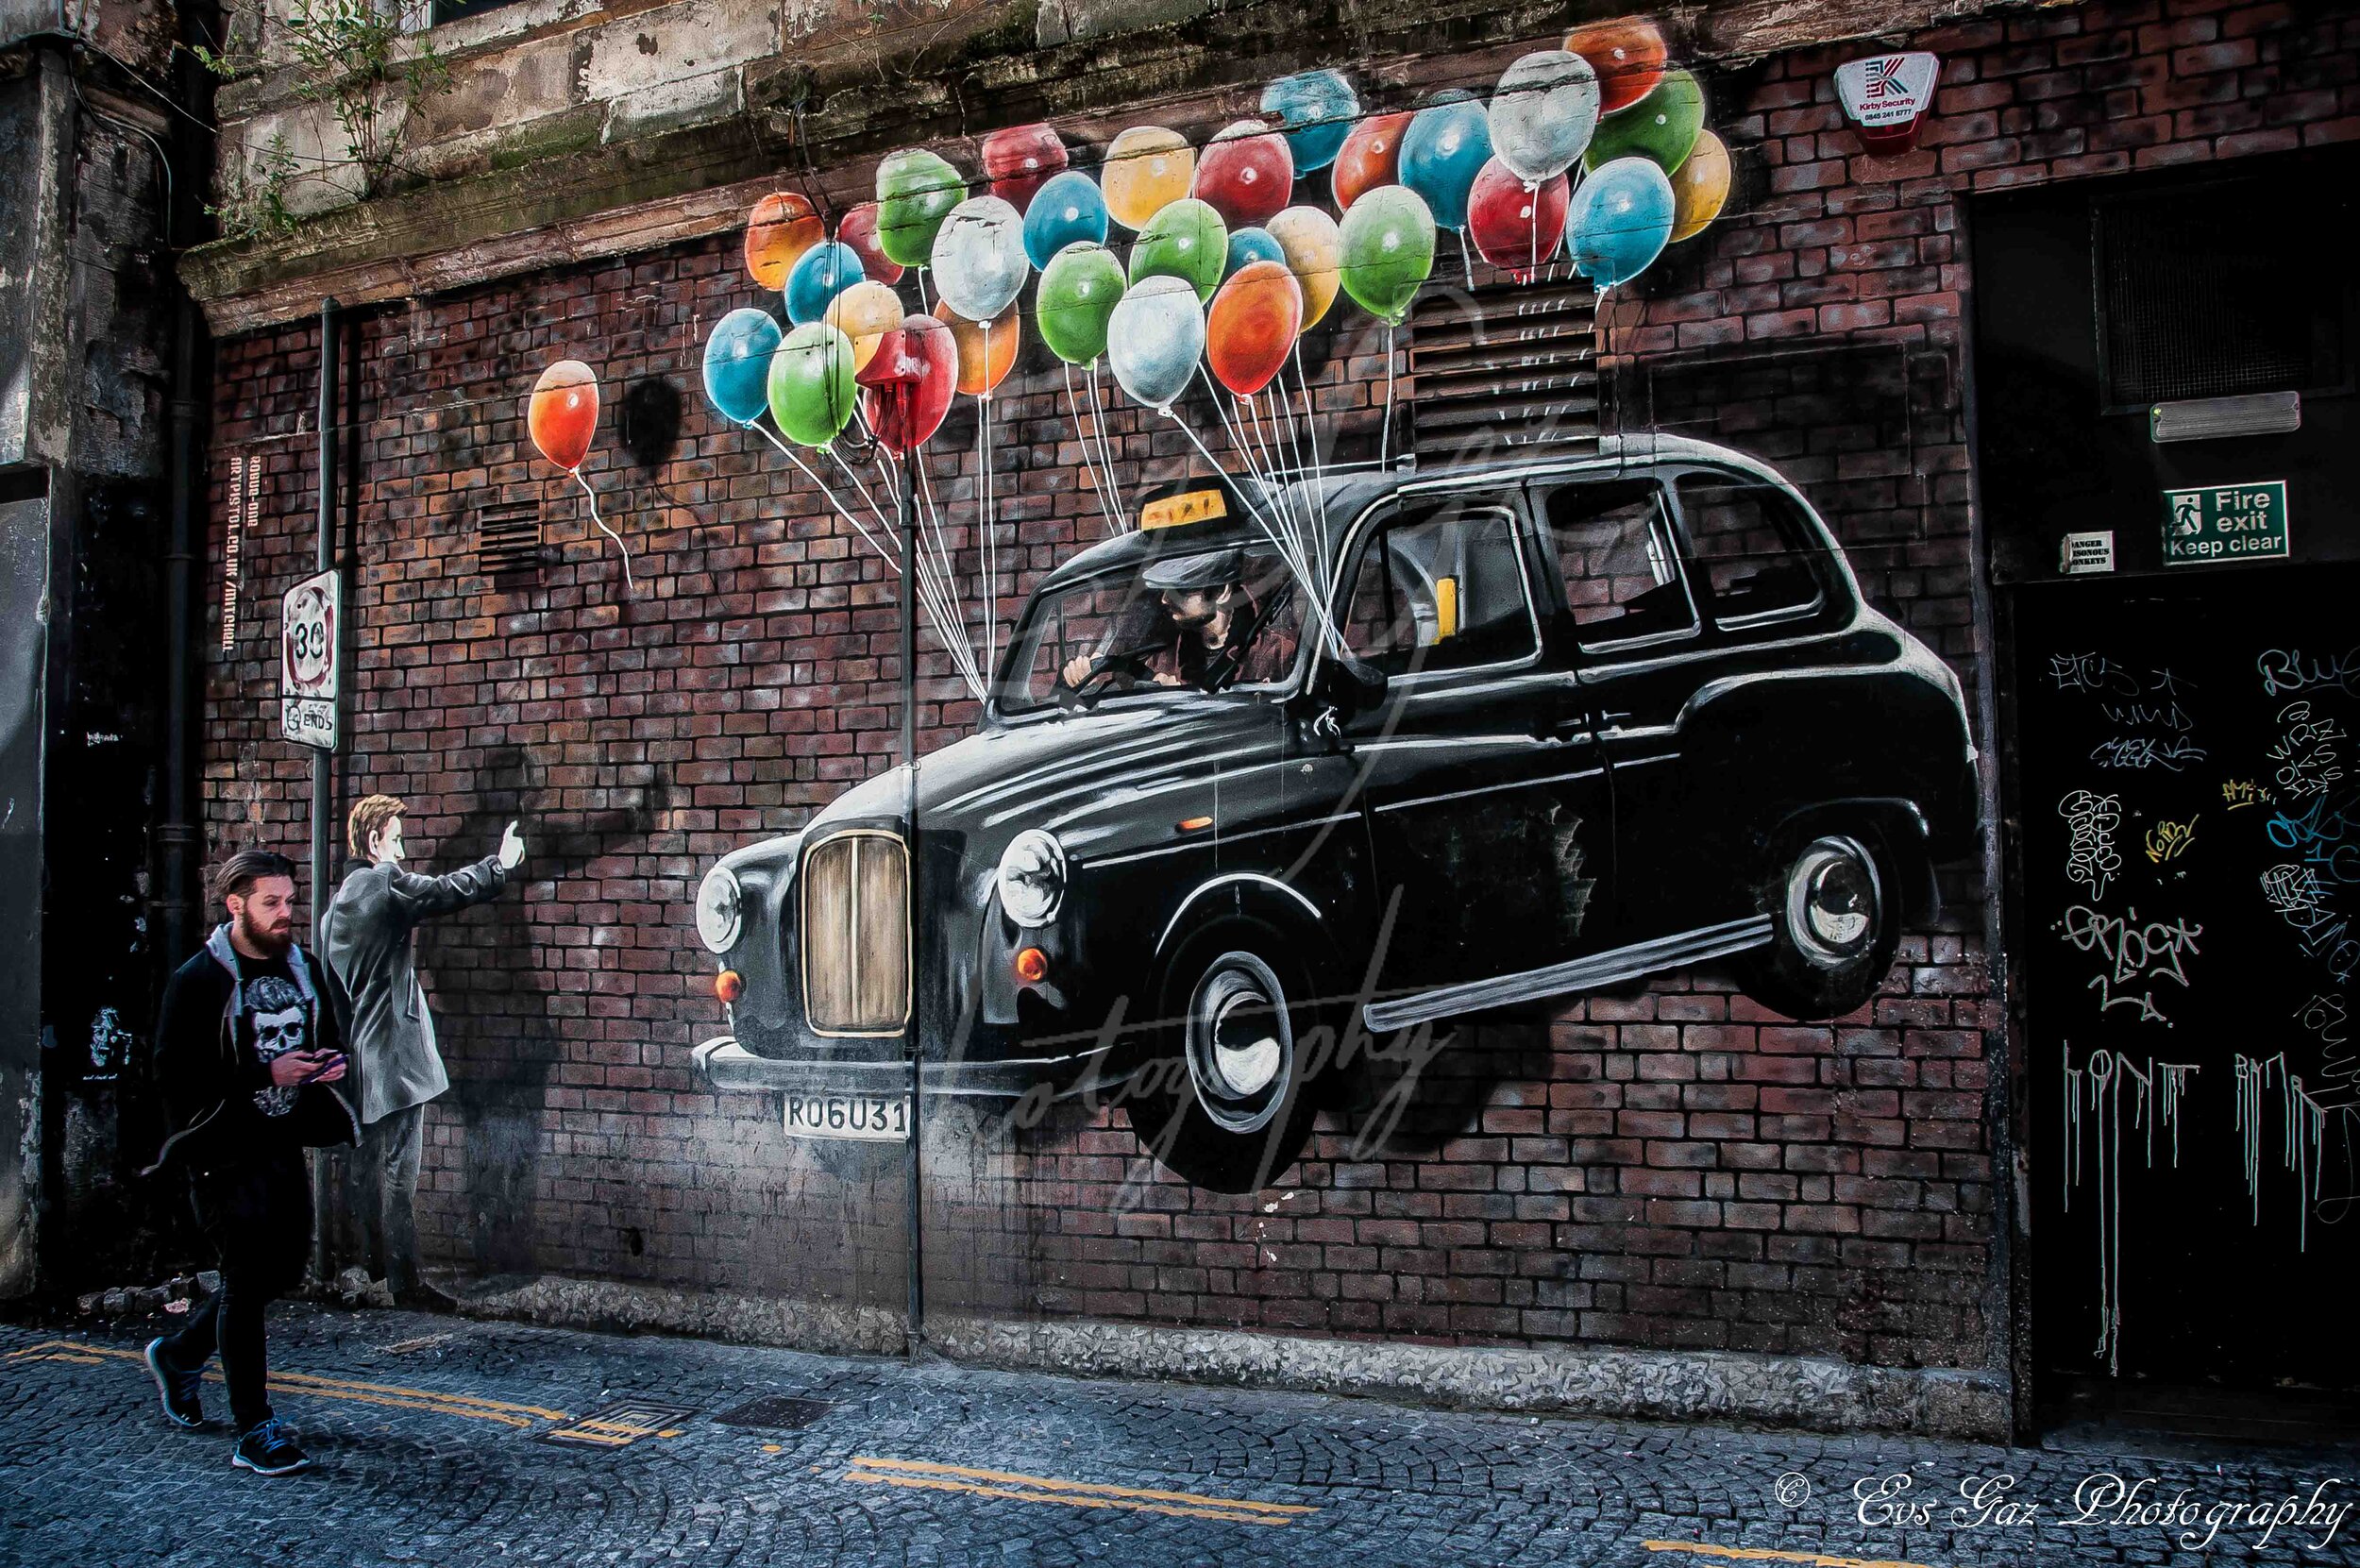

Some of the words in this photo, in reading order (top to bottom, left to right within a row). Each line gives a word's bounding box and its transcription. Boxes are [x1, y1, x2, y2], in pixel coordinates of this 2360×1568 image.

[1860, 102, 1881, 111] Kirby
[1881, 97, 1915, 109] Security
[1881, 110, 1895, 119] 241
[2216, 490, 2270, 512] Fire
[2217, 511, 2267, 533] exit
[2073, 548, 2110, 557] ISONOUS
[2170, 539, 2223, 558] Keep
[2229, 535, 2283, 553] clear
[295, 622, 324, 660] 30
[303, 713, 333, 731] ENDS
